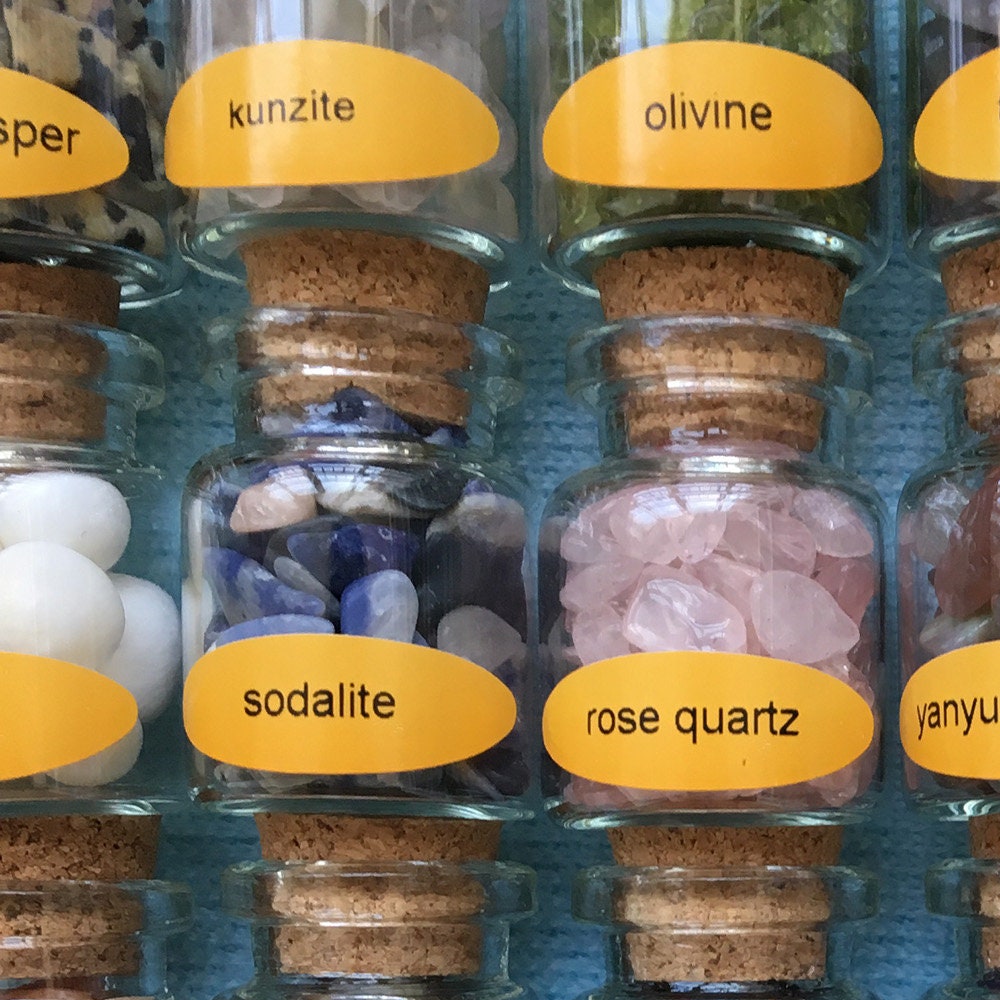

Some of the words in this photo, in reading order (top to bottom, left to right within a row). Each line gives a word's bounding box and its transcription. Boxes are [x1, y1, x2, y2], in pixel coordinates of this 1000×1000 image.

[229, 92, 354, 128] kunzite
[646, 95, 772, 131] olivine
[243, 682, 396, 719] sodalite
[587, 707, 660, 735] rose
[675, 701, 799, 744] quartz
